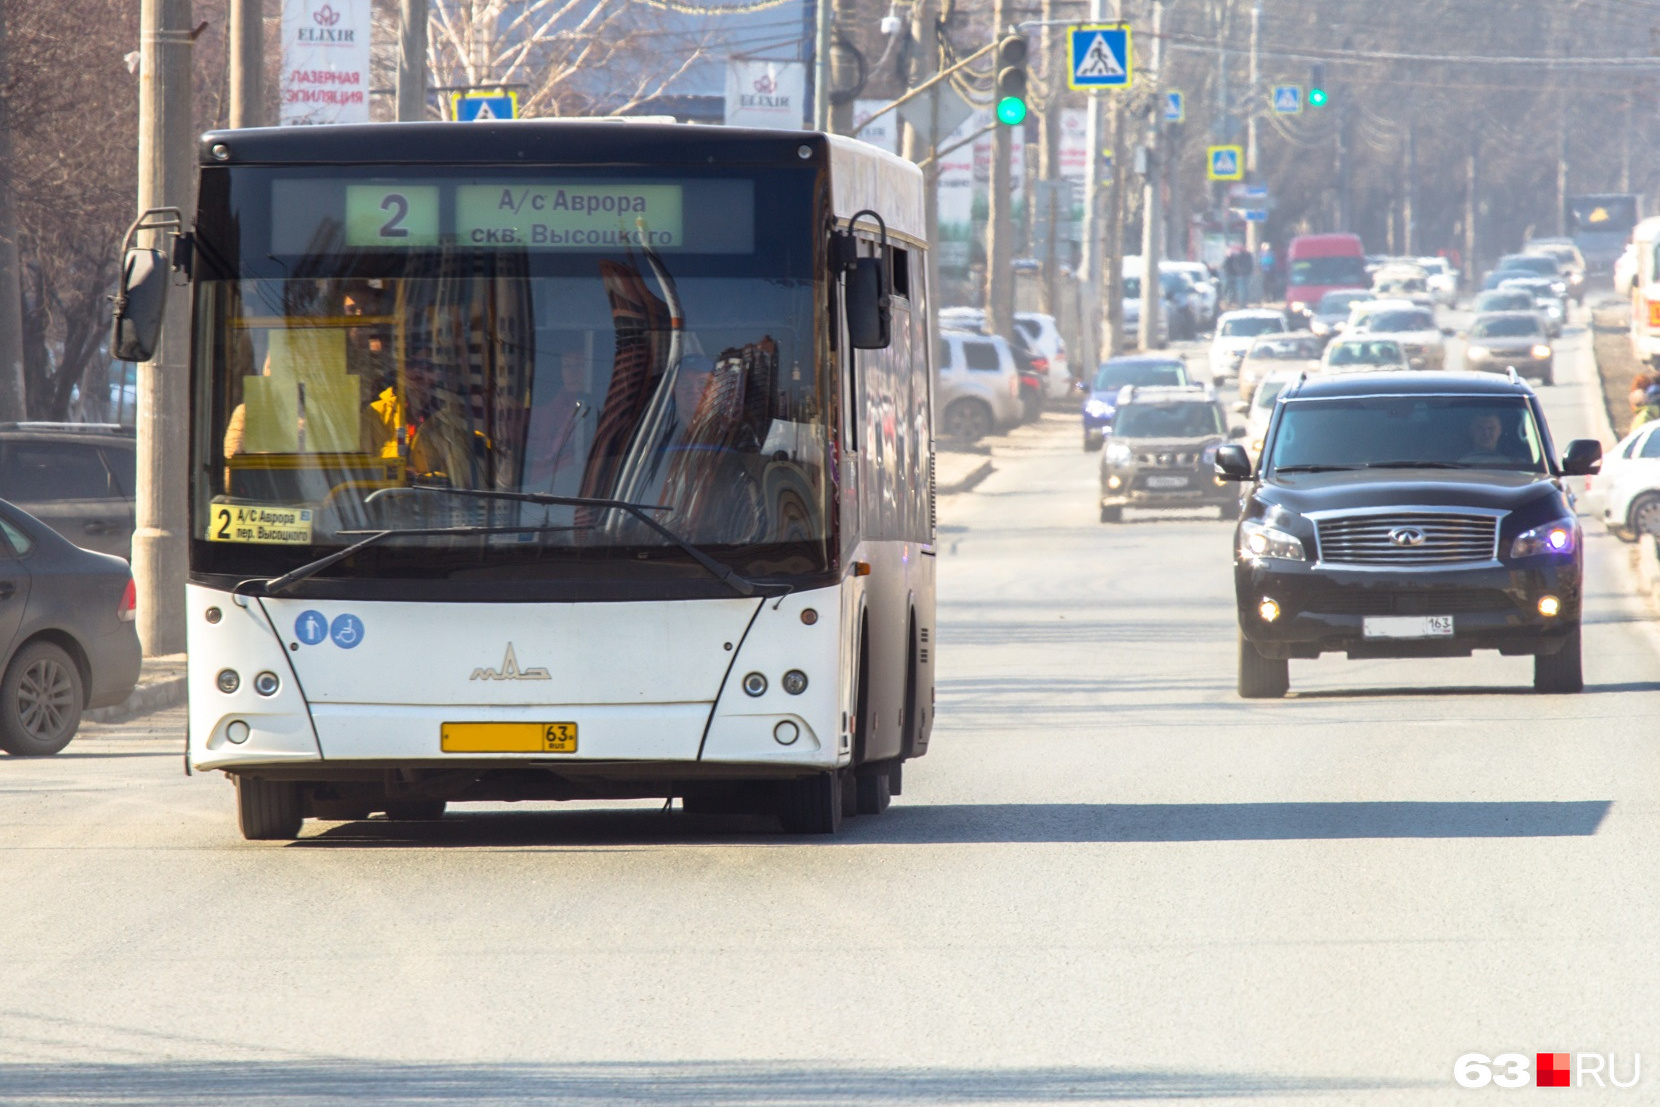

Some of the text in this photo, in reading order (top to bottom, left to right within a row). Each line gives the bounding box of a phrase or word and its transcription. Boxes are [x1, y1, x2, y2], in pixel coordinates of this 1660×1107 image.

[298, 28, 354, 42] ELIXIR
[290, 70, 360, 84] ЛАЗЕРНАЯ
[286, 89, 363, 106] ЭПИЛЯЦИЯ
[740, 94, 790, 107] ELIXIR
[499, 189, 647, 215] А/с Аврора
[379, 194, 409, 237] 2
[471, 224, 673, 246] скв. Высоцкого
[217, 508, 231, 539] 2
[237, 509, 257, 524] А/С
[260, 510, 295, 526] Аврора
[258, 526, 308, 542] Высоцкого
[1428, 617, 1451, 629] 163
[546, 725, 568, 742] 63
